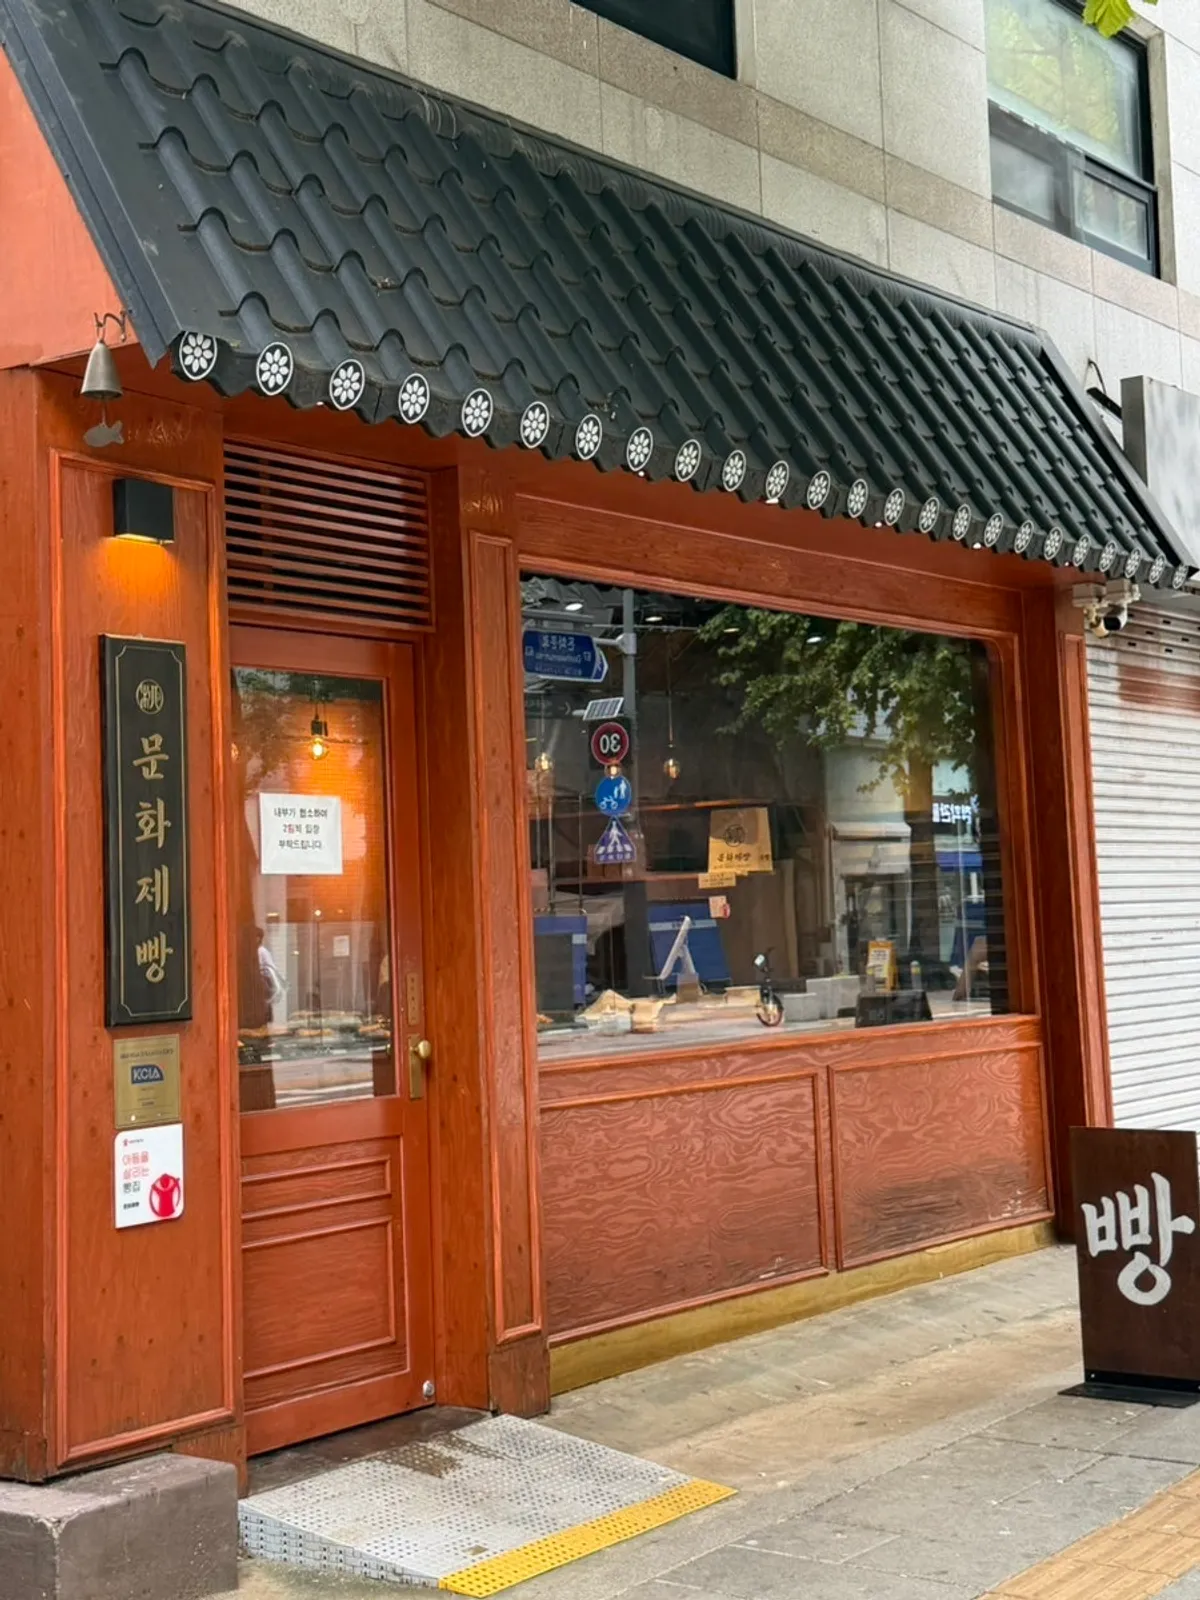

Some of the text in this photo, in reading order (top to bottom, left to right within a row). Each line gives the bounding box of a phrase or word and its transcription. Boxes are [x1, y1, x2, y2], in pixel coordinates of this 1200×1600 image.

[274, 807, 328, 819] 내부가 협소하여
[305, 824, 320, 834] 입장
[278, 839, 322, 850] 부탁드립니다
[132, 733, 174, 983] 문화제빵
[133, 1067, 161, 1081] KCIA
[1081, 1172, 1195, 1306] 빵
